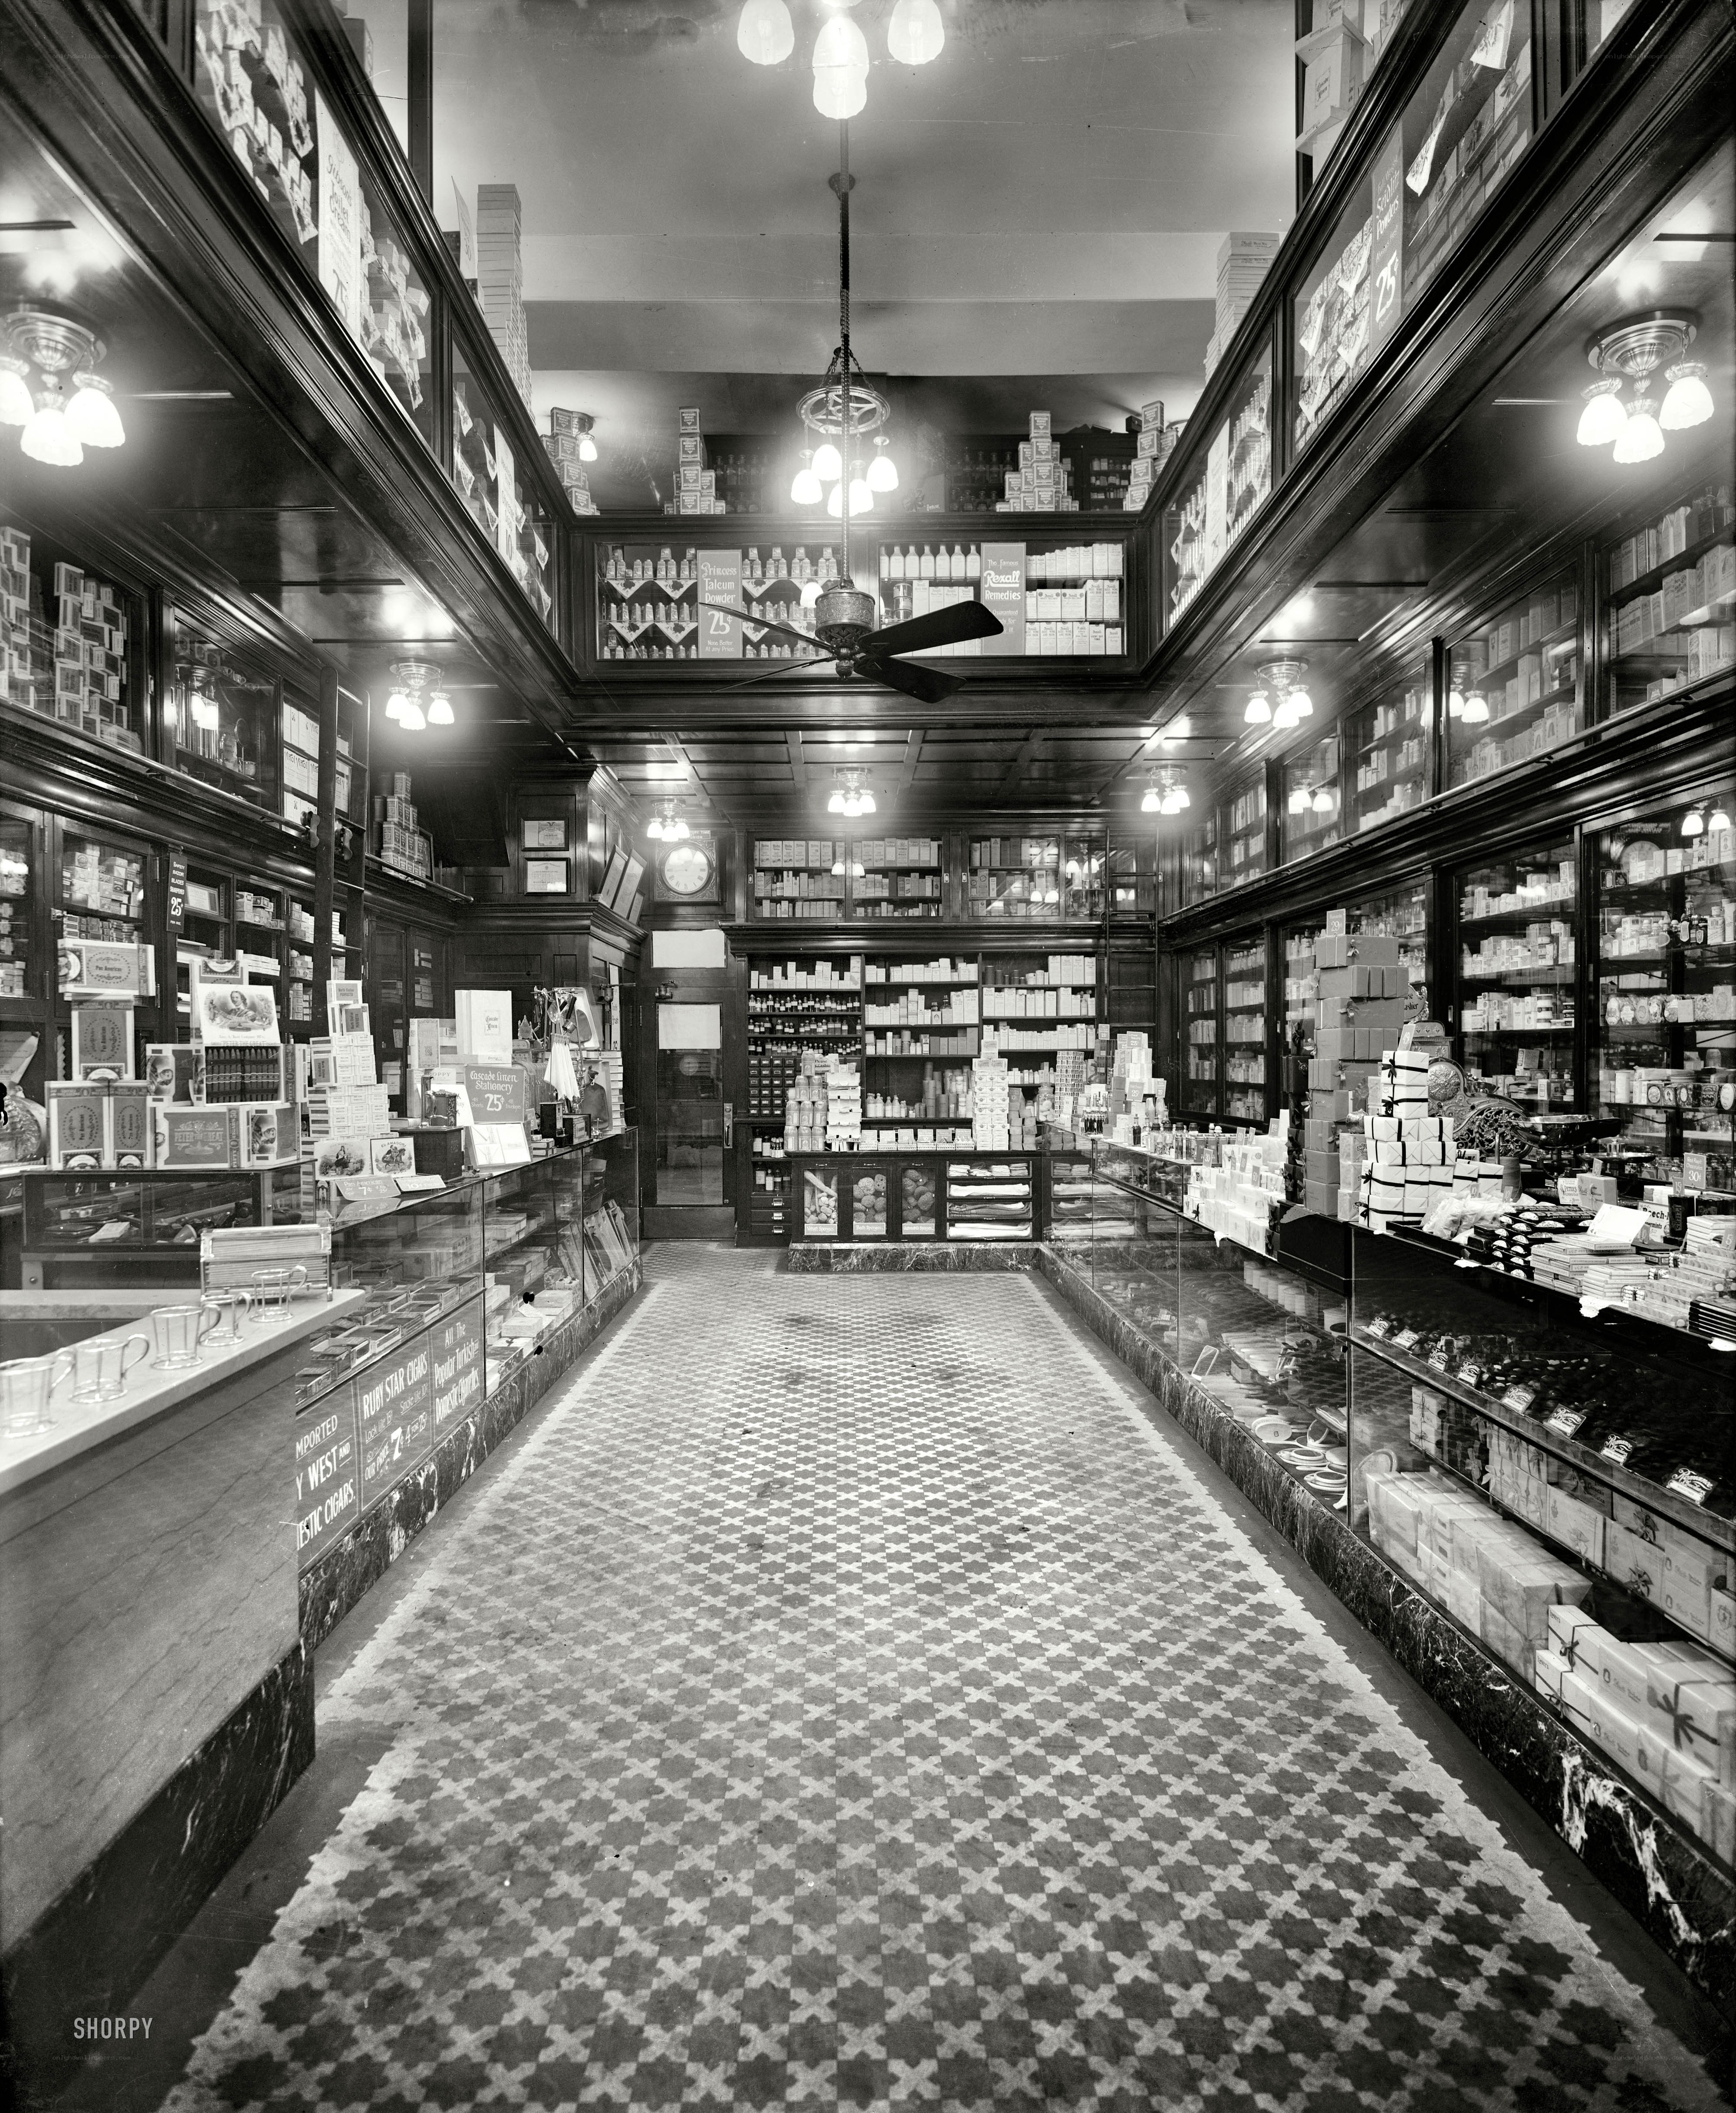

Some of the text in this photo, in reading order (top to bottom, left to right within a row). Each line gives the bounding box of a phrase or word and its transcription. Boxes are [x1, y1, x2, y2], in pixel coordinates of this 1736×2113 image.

[701, 563, 736, 578] Princess
[1000, 559, 1019, 569] Famous
[703, 578, 734, 591] Talcum
[983, 570, 1020, 587] Rexall
[705, 592, 736, 604] Powder
[985, 590, 1021, 600] Remedies
[171, 897, 183, 916] 25¢
[470, 1070, 519, 1082] Cascade Linen
[476, 1080, 513, 1095] Stationery
[484, 1093, 505, 1111] 25¢
[445, 1322, 466, 1347] All The
[434, 1356, 455, 1388] Popular
[456, 1338, 474, 1371] Turkish
[363, 1351, 427, 1419] RUBY STAR CIGARS
[436, 1383, 458, 1425] Domestic
[296, 1415, 338, 1459] MPORTED
[391, 1426, 404, 1461] 7¢
[308, 1445, 337, 1490] WEST
[339, 1442, 351, 1460] AND
[365, 1441, 389, 1480] OUR PRICE
